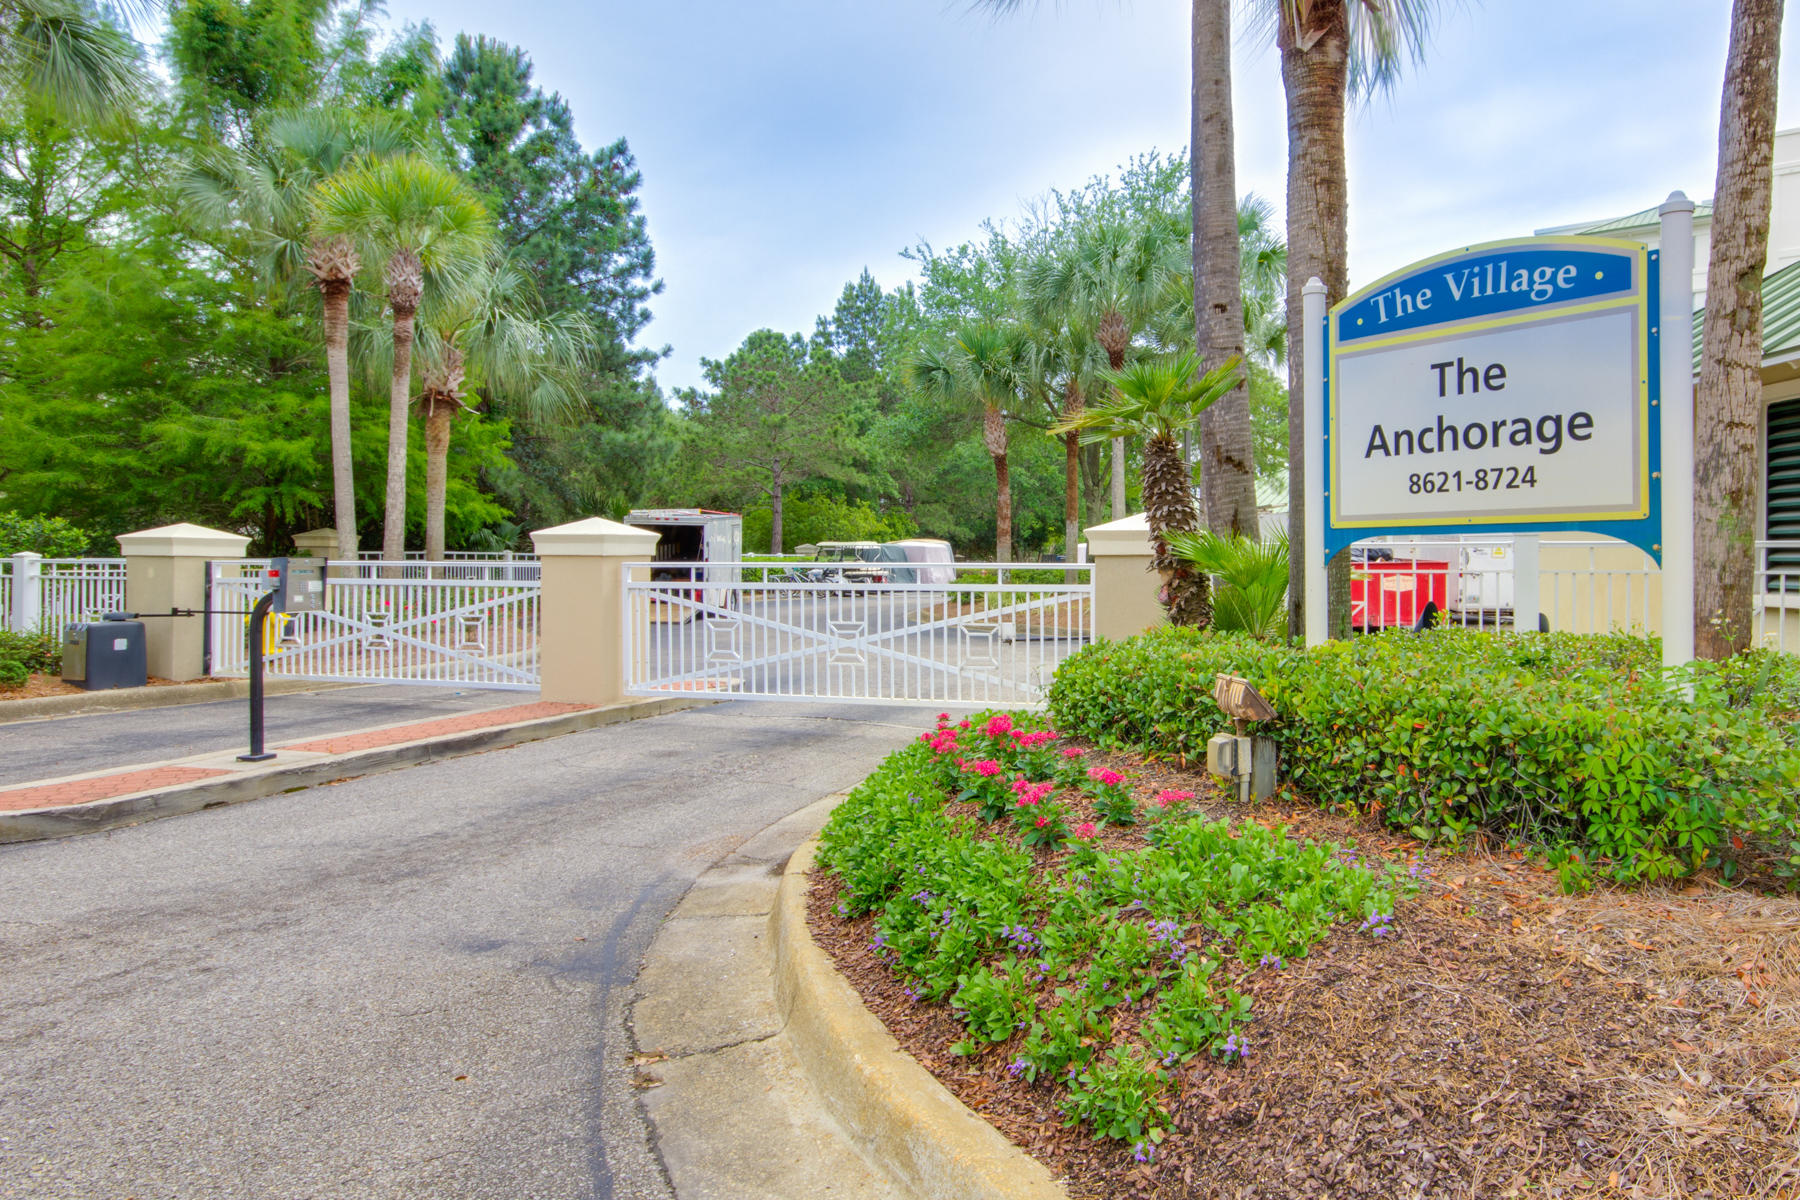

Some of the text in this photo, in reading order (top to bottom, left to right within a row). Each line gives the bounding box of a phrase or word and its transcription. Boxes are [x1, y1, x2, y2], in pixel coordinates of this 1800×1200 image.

[1370, 261, 1578, 324] The Village
[1430, 357, 1507, 398] The
[1364, 410, 1594, 459] Anchorage
[1408, 466, 1537, 494] 8621-8724
